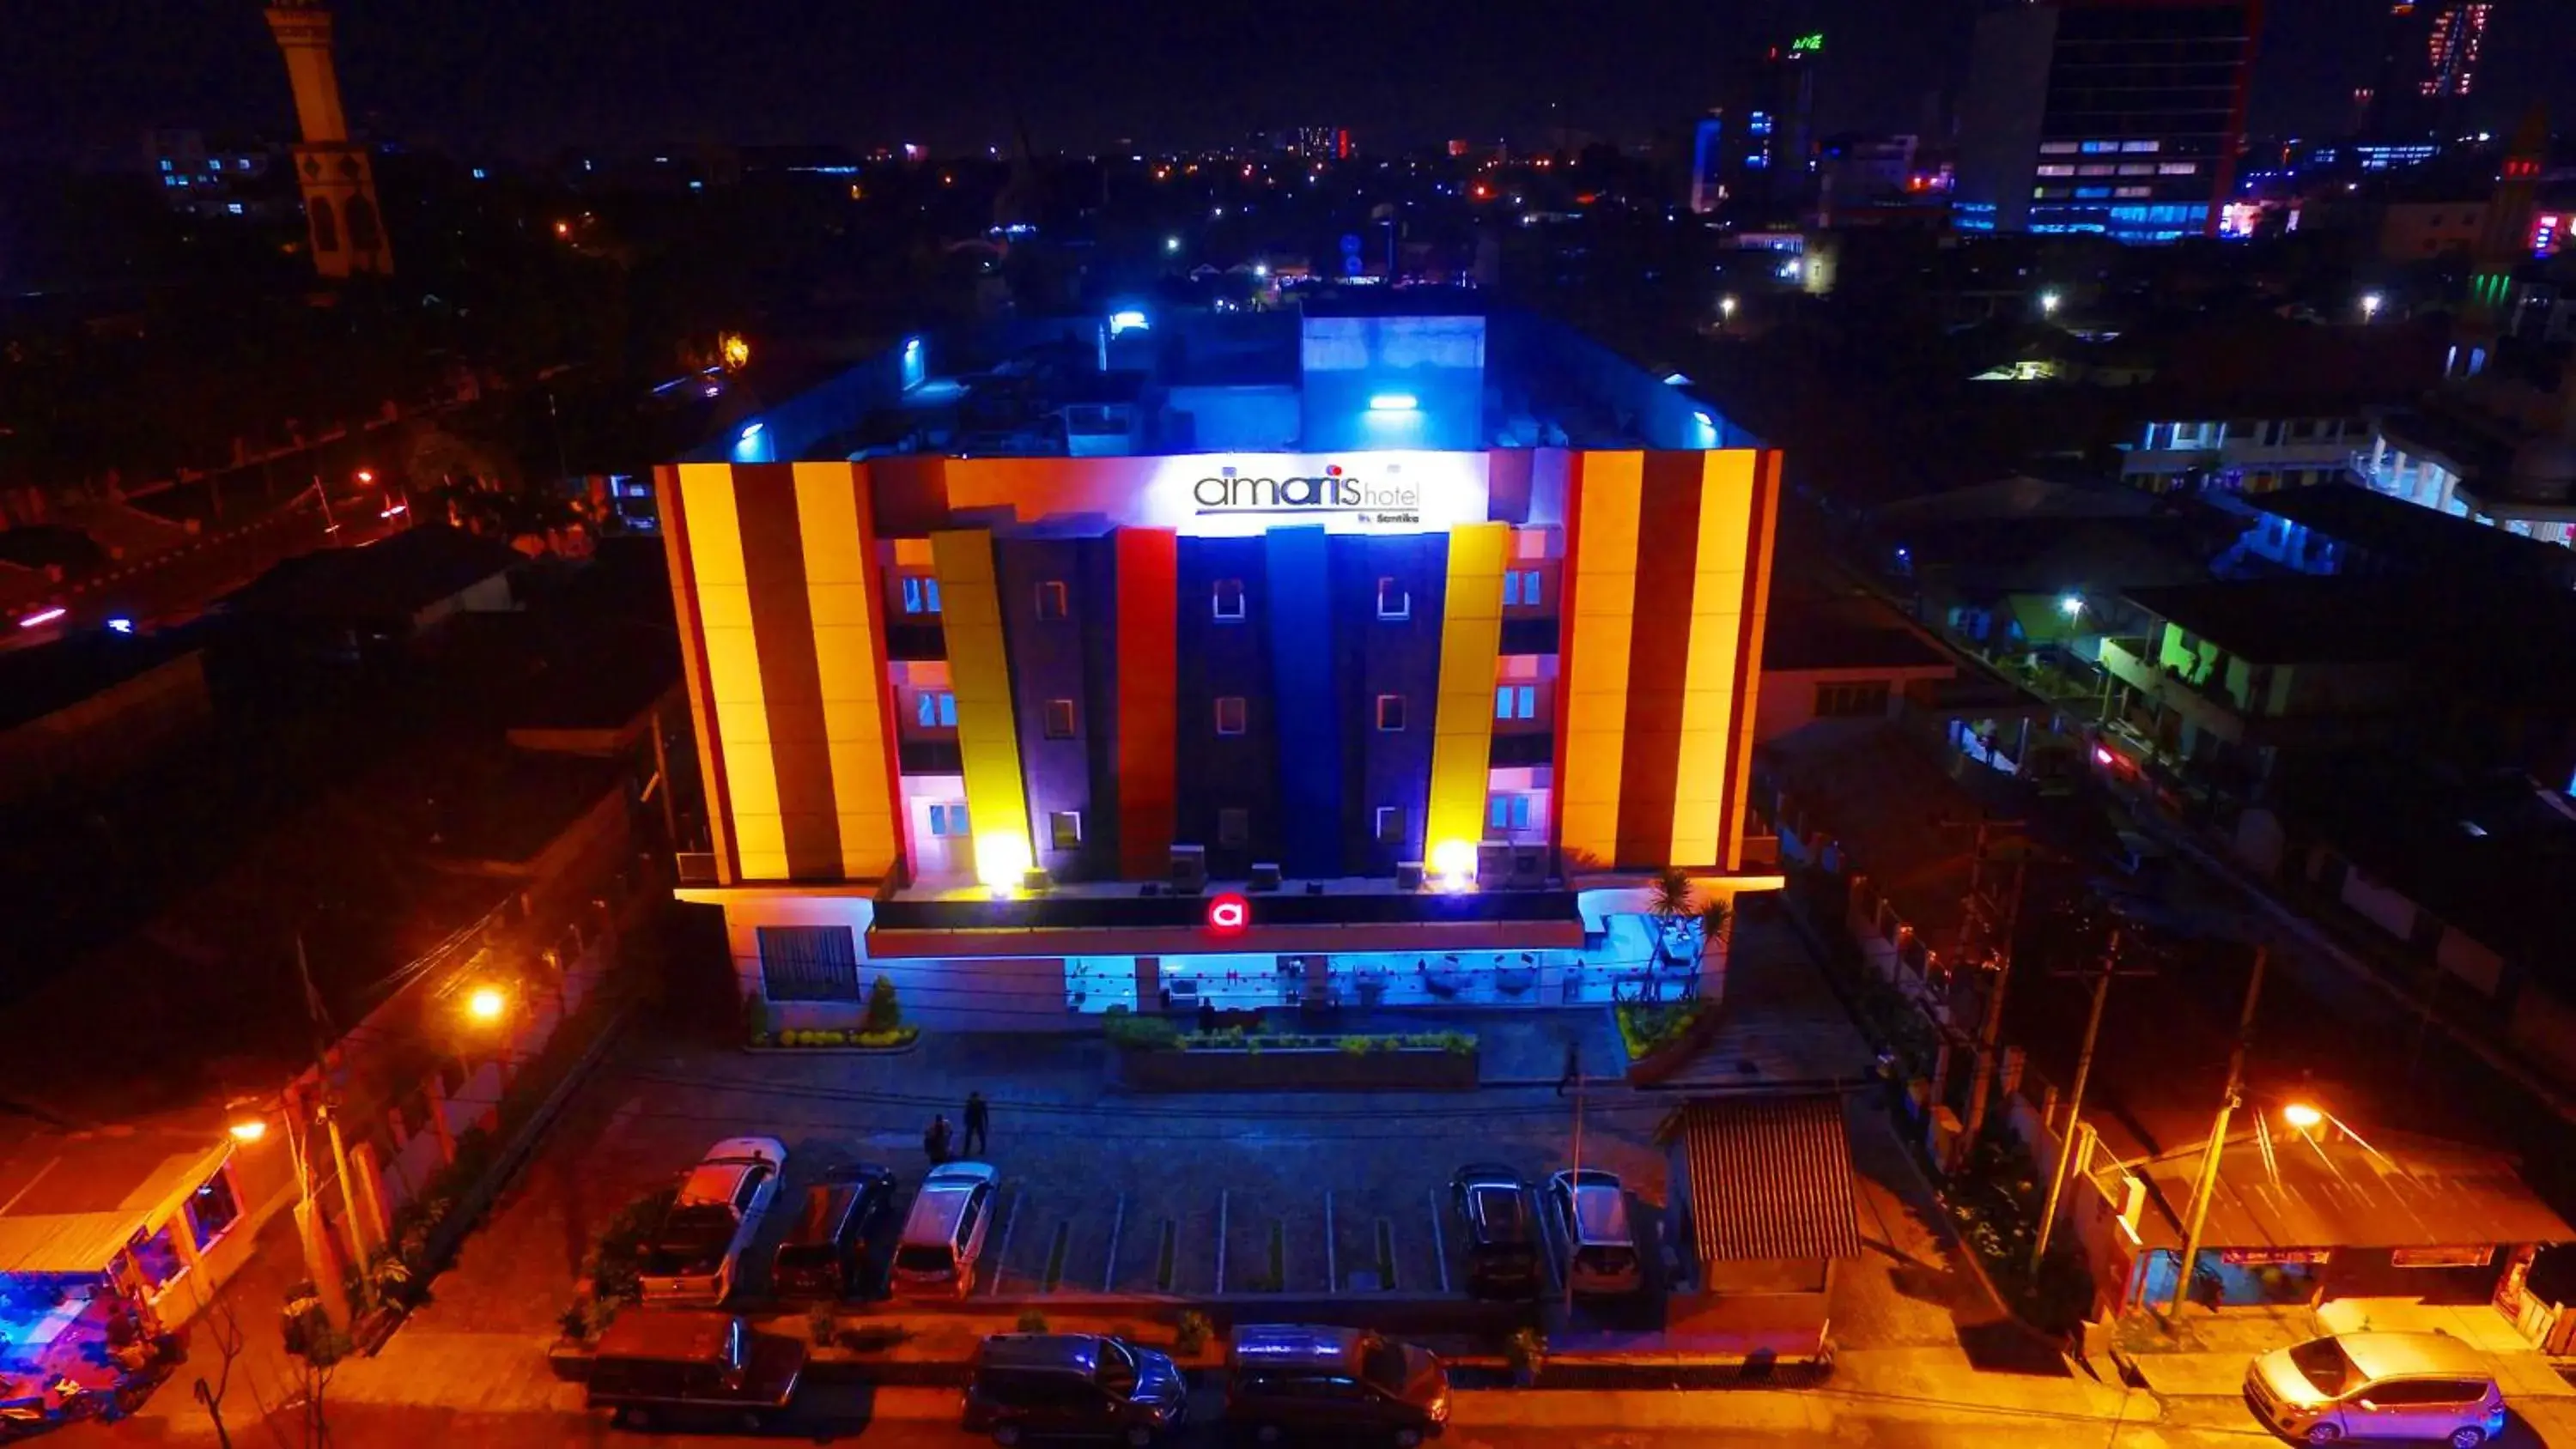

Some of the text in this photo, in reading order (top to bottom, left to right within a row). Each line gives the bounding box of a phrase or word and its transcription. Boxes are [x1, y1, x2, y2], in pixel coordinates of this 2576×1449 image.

[1193, 464, 1420, 506] amaris hotel
[1213, 903, 1242, 927] a
